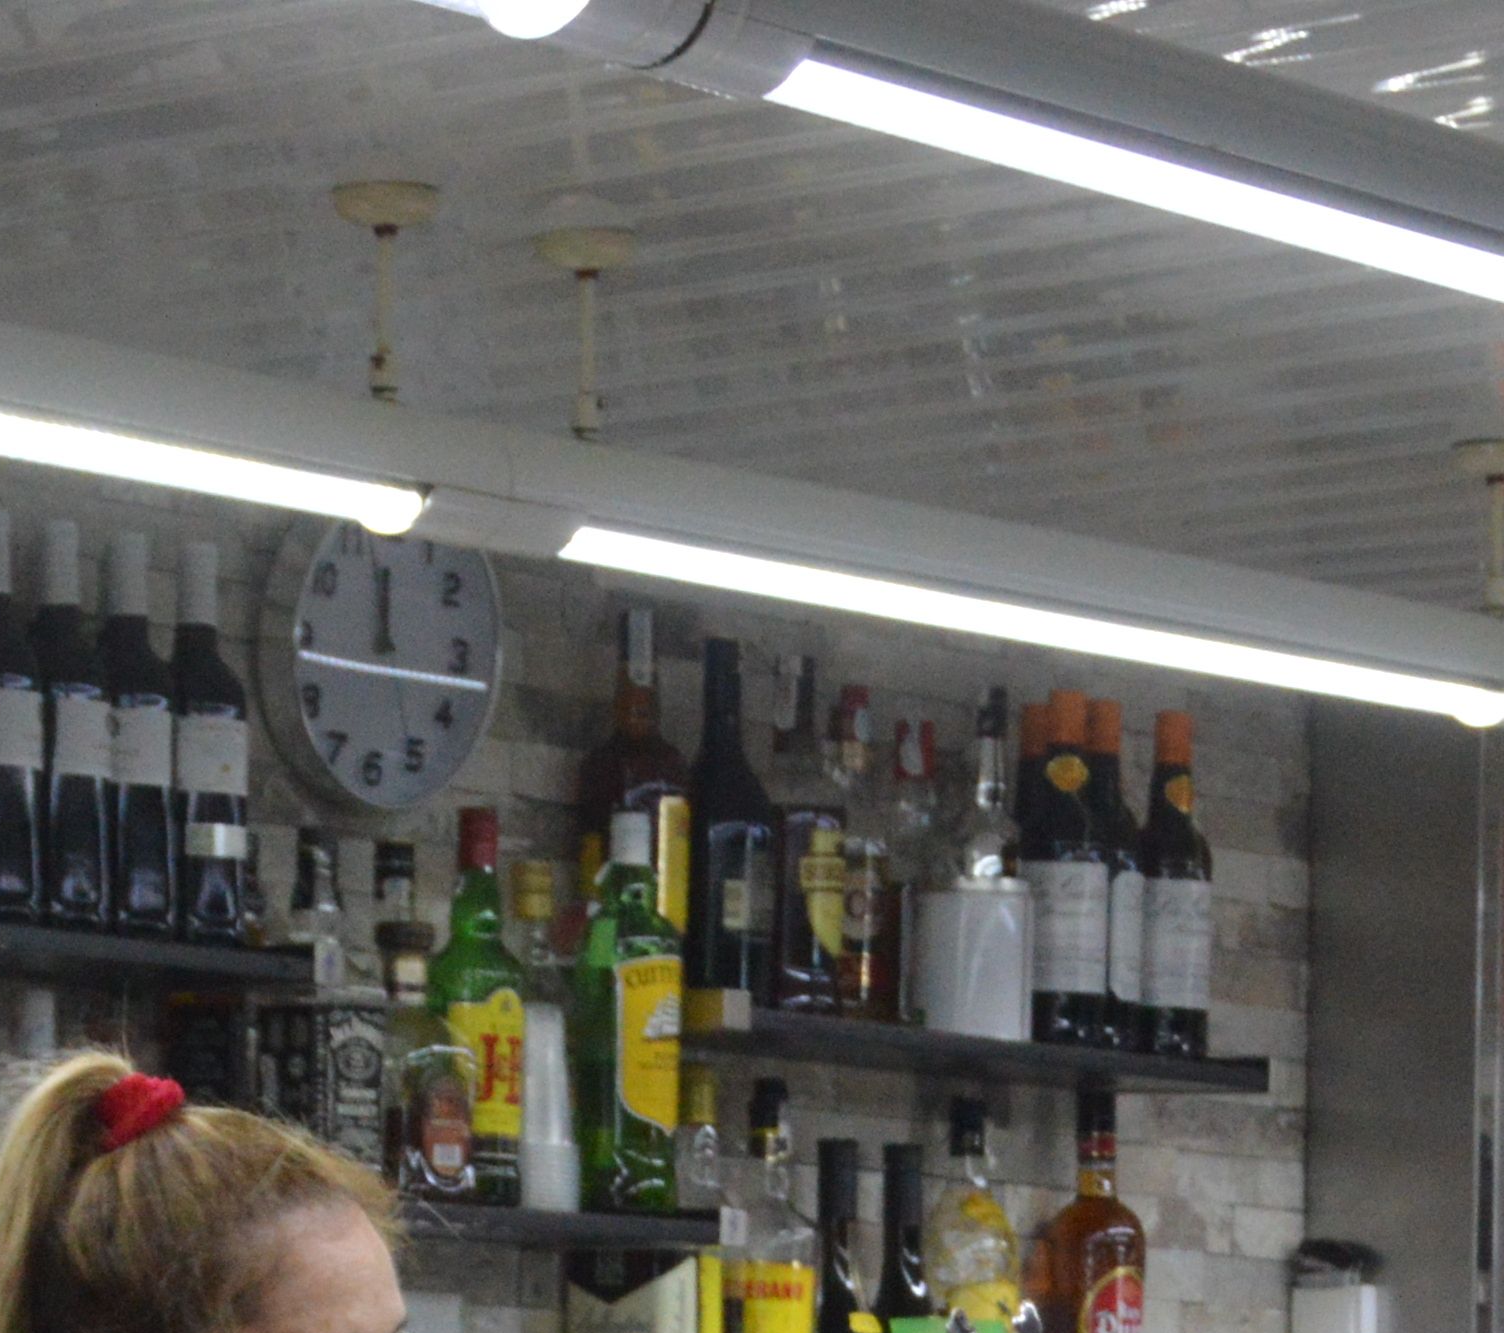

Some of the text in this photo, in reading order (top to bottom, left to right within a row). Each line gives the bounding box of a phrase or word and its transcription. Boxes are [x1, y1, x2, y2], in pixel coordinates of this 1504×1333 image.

[441, 572, 461, 608] 2
[449, 638, 470, 674] 3
[434, 700, 455, 730] 4
[327, 730, 349, 765] 7
[405, 736, 425, 774] 5
[363, 751, 383, 787] 6
